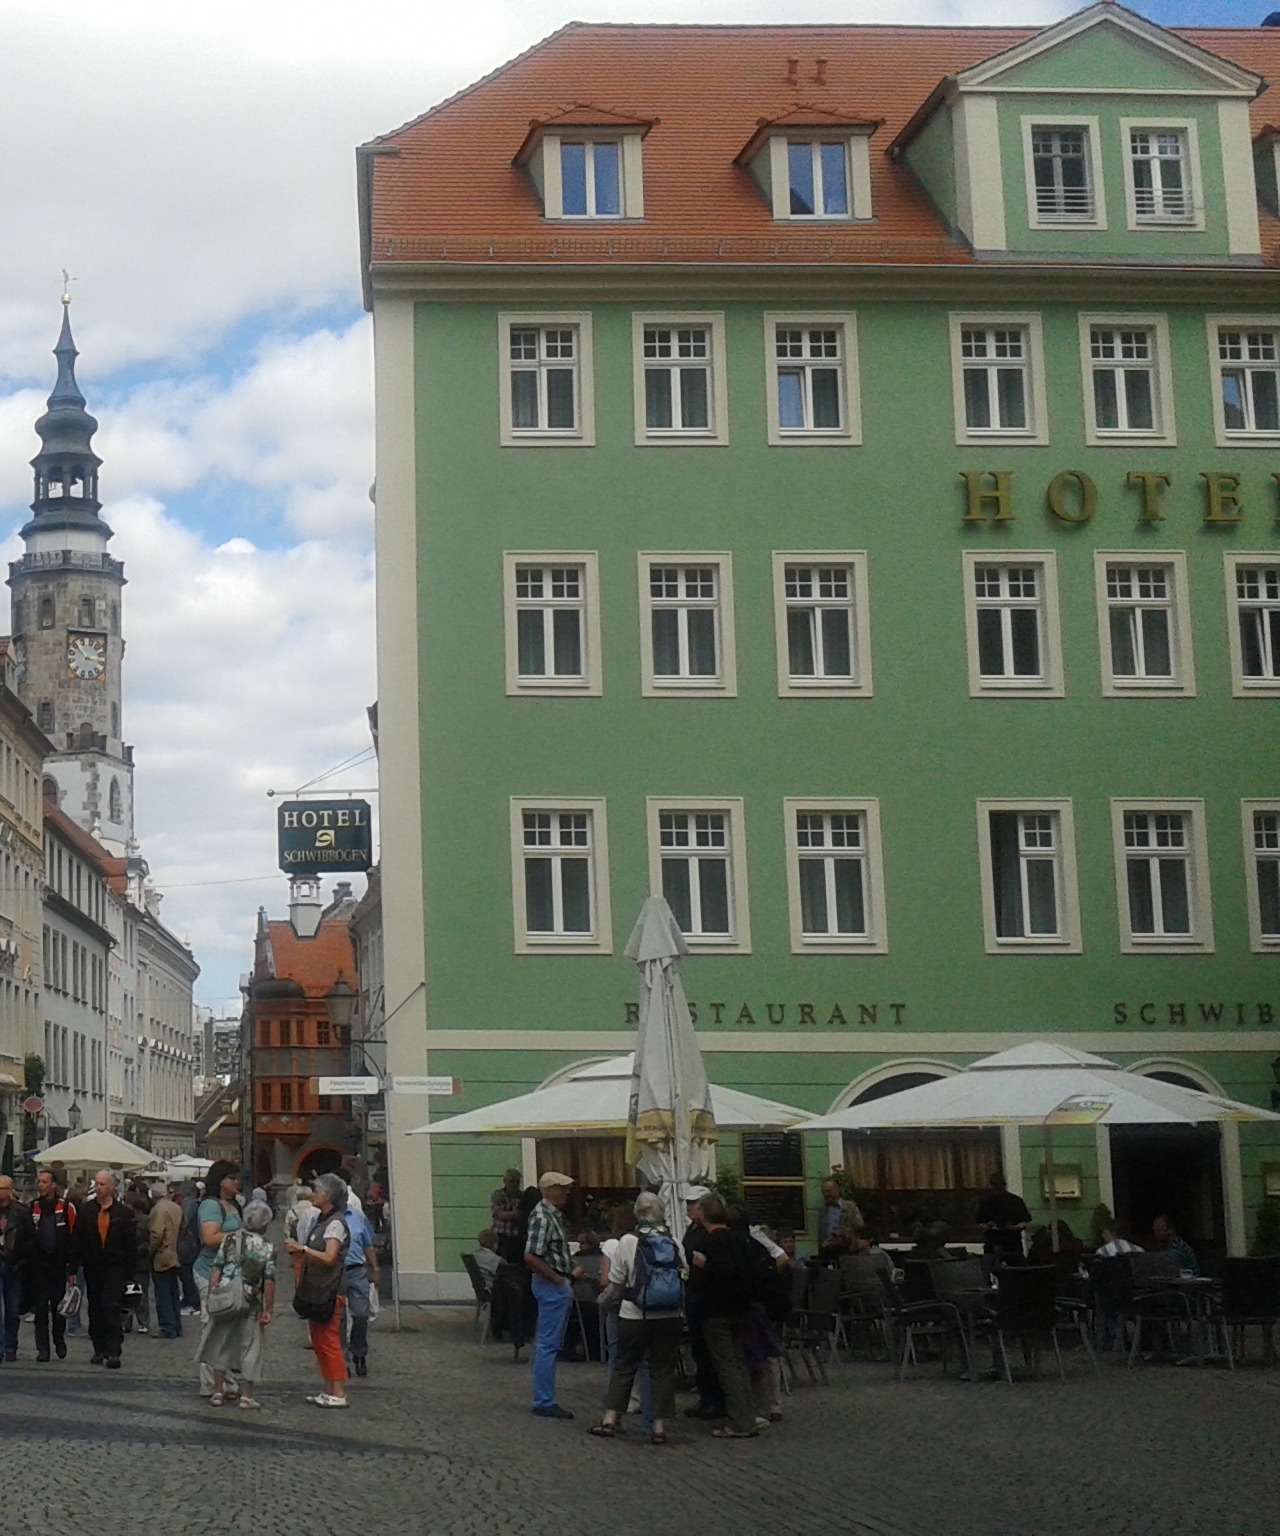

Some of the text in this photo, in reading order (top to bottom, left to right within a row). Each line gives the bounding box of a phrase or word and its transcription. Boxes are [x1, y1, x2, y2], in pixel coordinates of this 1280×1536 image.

[958, 469, 1280, 522] HOTE
[283, 810, 367, 828] HOTEL
[283, 849, 368, 863] SCHWIBBOGEN
[624, 1002, 907, 1025] RSTAURANT
